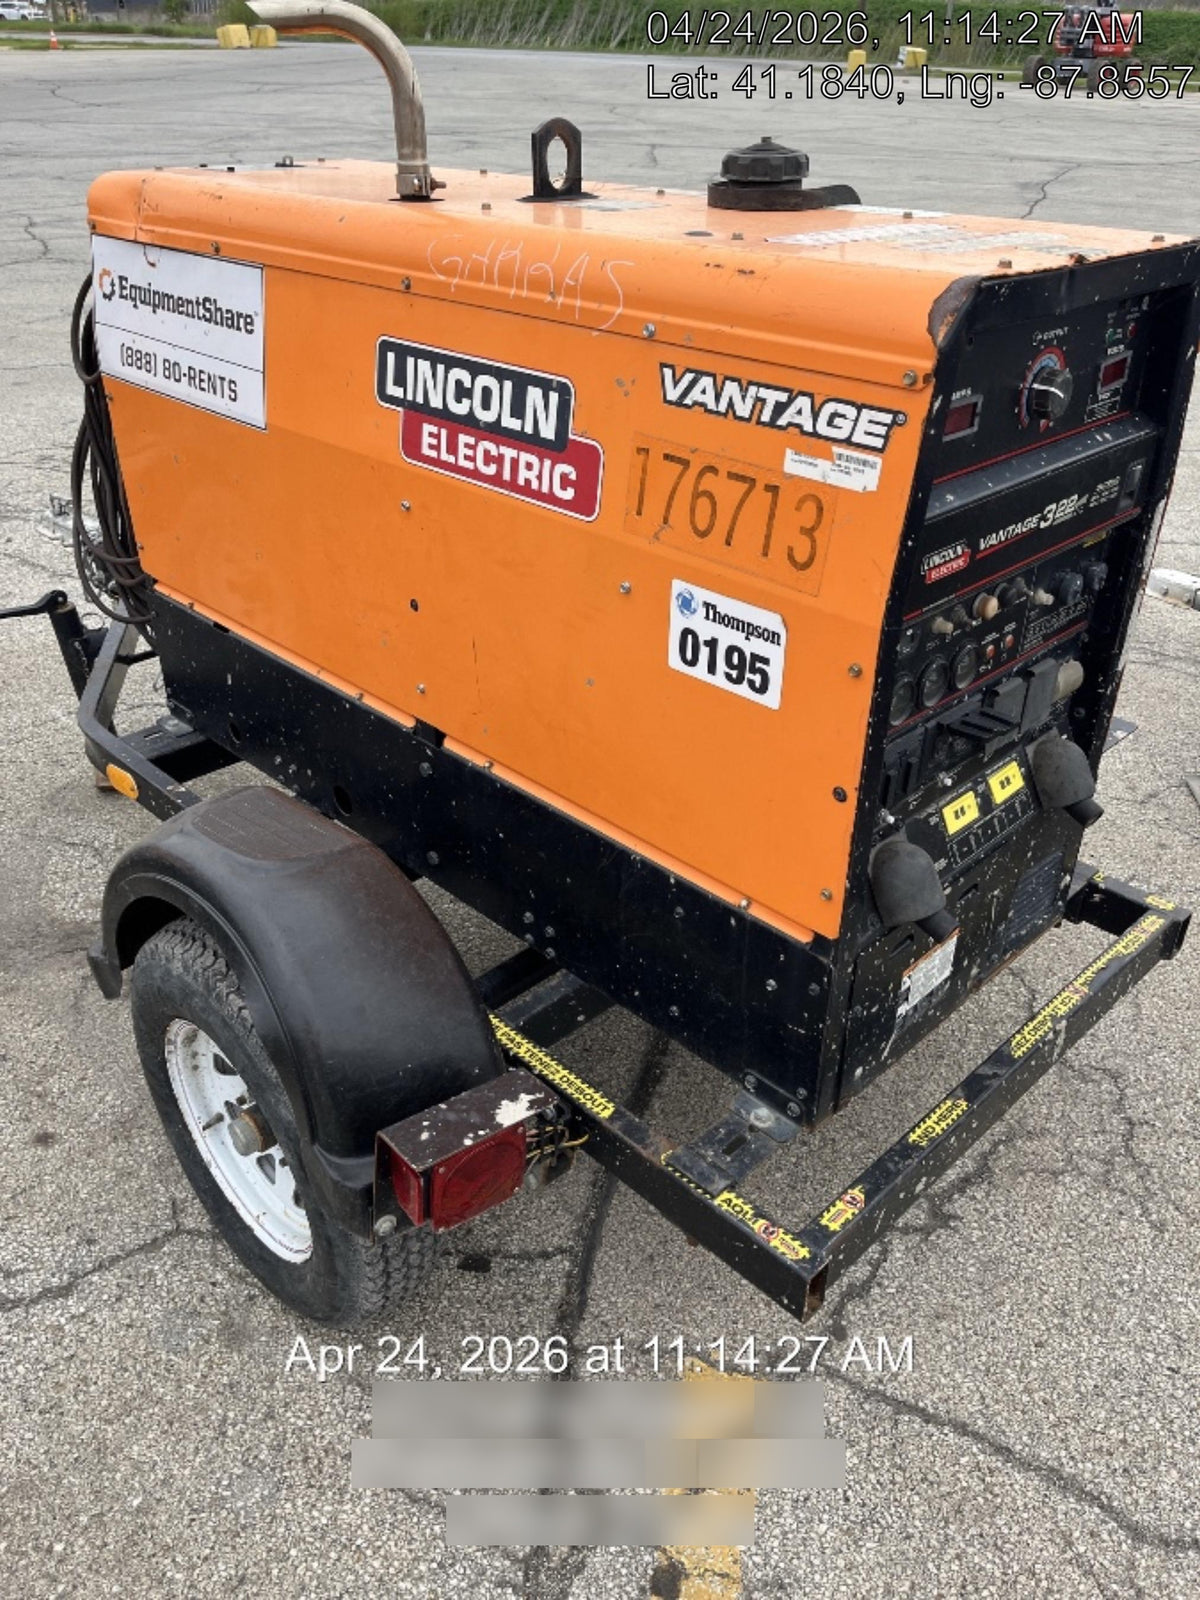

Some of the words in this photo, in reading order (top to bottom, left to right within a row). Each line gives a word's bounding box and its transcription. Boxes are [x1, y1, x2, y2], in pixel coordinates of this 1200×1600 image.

[118, 275, 256, 335] EquipmentShare
[120, 343, 157, 378] (888)
[162, 358, 238, 403] 80-RENTS
[386, 352, 559, 441] LINCOLN
[659, 365, 894, 452] VANTAGE
[421, 423, 577, 501] ELECTRIC
[635, 447, 825, 571] 176713
[979, 513, 1042, 550] VANTAGE
[702, 600, 782, 647] Thompson
[678, 626, 770, 696] 0195
[559, 1072, 610, 1115] DEBOUT
